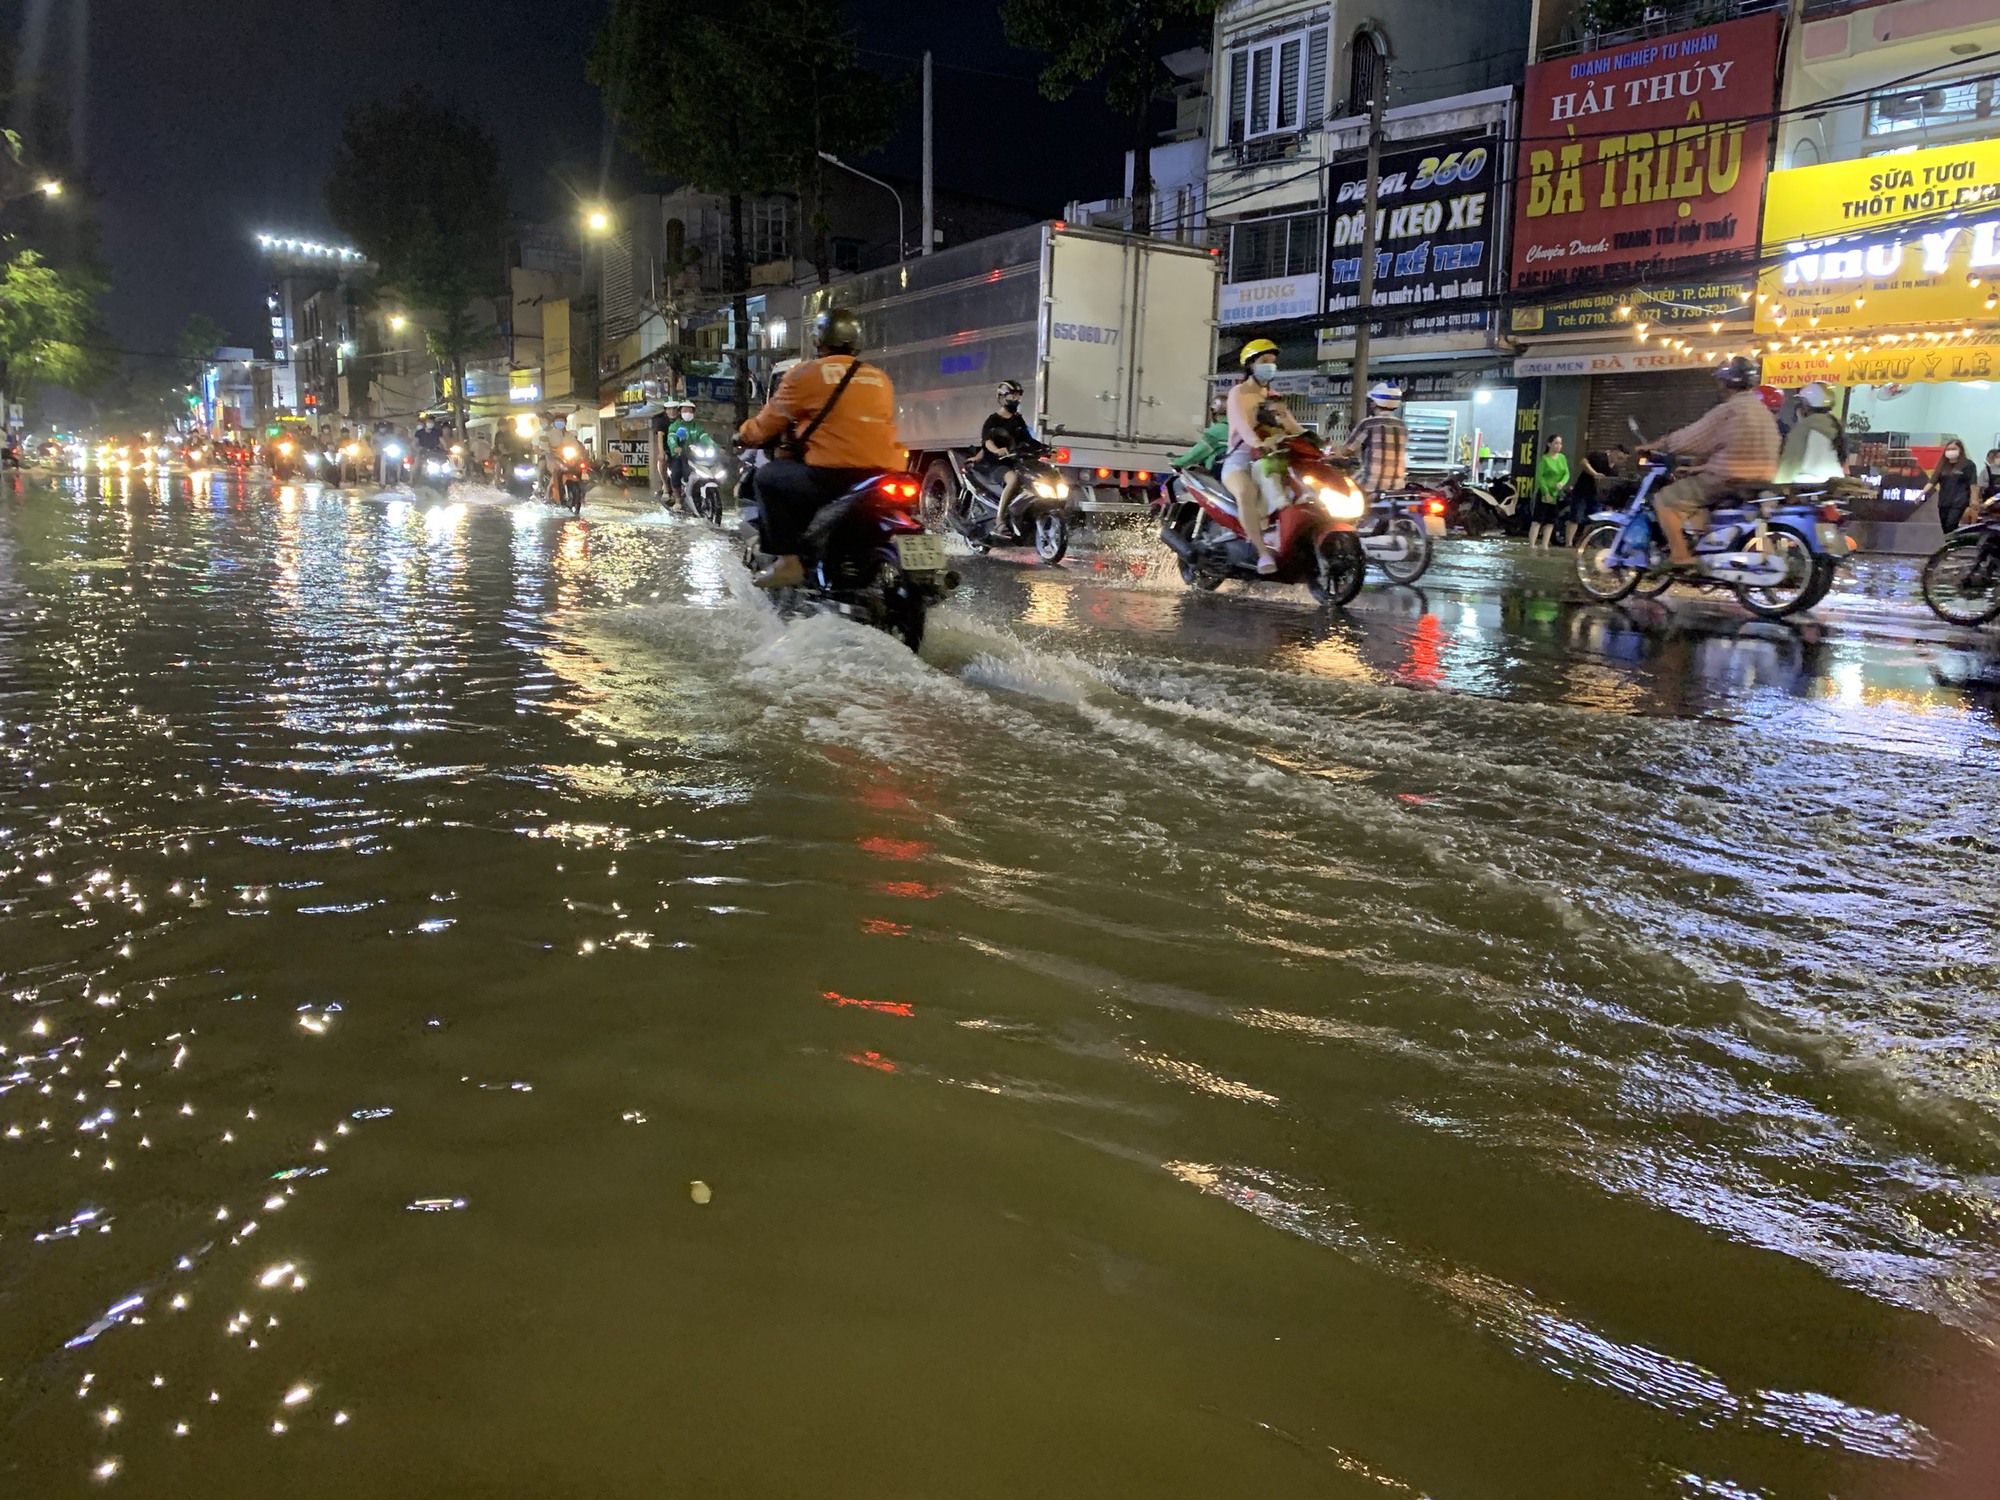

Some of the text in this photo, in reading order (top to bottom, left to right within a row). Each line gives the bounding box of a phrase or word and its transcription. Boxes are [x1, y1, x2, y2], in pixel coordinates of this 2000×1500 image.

[1570, 58, 1610, 80] DOANH
[1614, 46, 1658, 70] NGHIỆP
[1681, 32, 1718, 56] NHÂN
[1550, 61, 1735, 121] HẢI THÚY
[1526, 101, 1748, 218] BÀ TRIỆU
[1336, 148, 1487, 204] DEAL 360
[1869, 161, 1975, 192] SỮA TƯƠI
[1446, 192, 1487, 231] XE
[1843, 191, 1897, 219] THỐT
[1394, 240, 1431, 277] KẾ
[1433, 241, 1484, 272] TEM
[1526, 244, 1566, 264] Chuyên
[1569, 237, 1609, 255] Doanh:
[1682, 288, 1696, 301] TP.
[1557, 315, 1577, 327] Tel:
[1591, 355, 1625, 369] BÀ
[1847, 350, 1992, 381] NHƯ Ý LÊ
